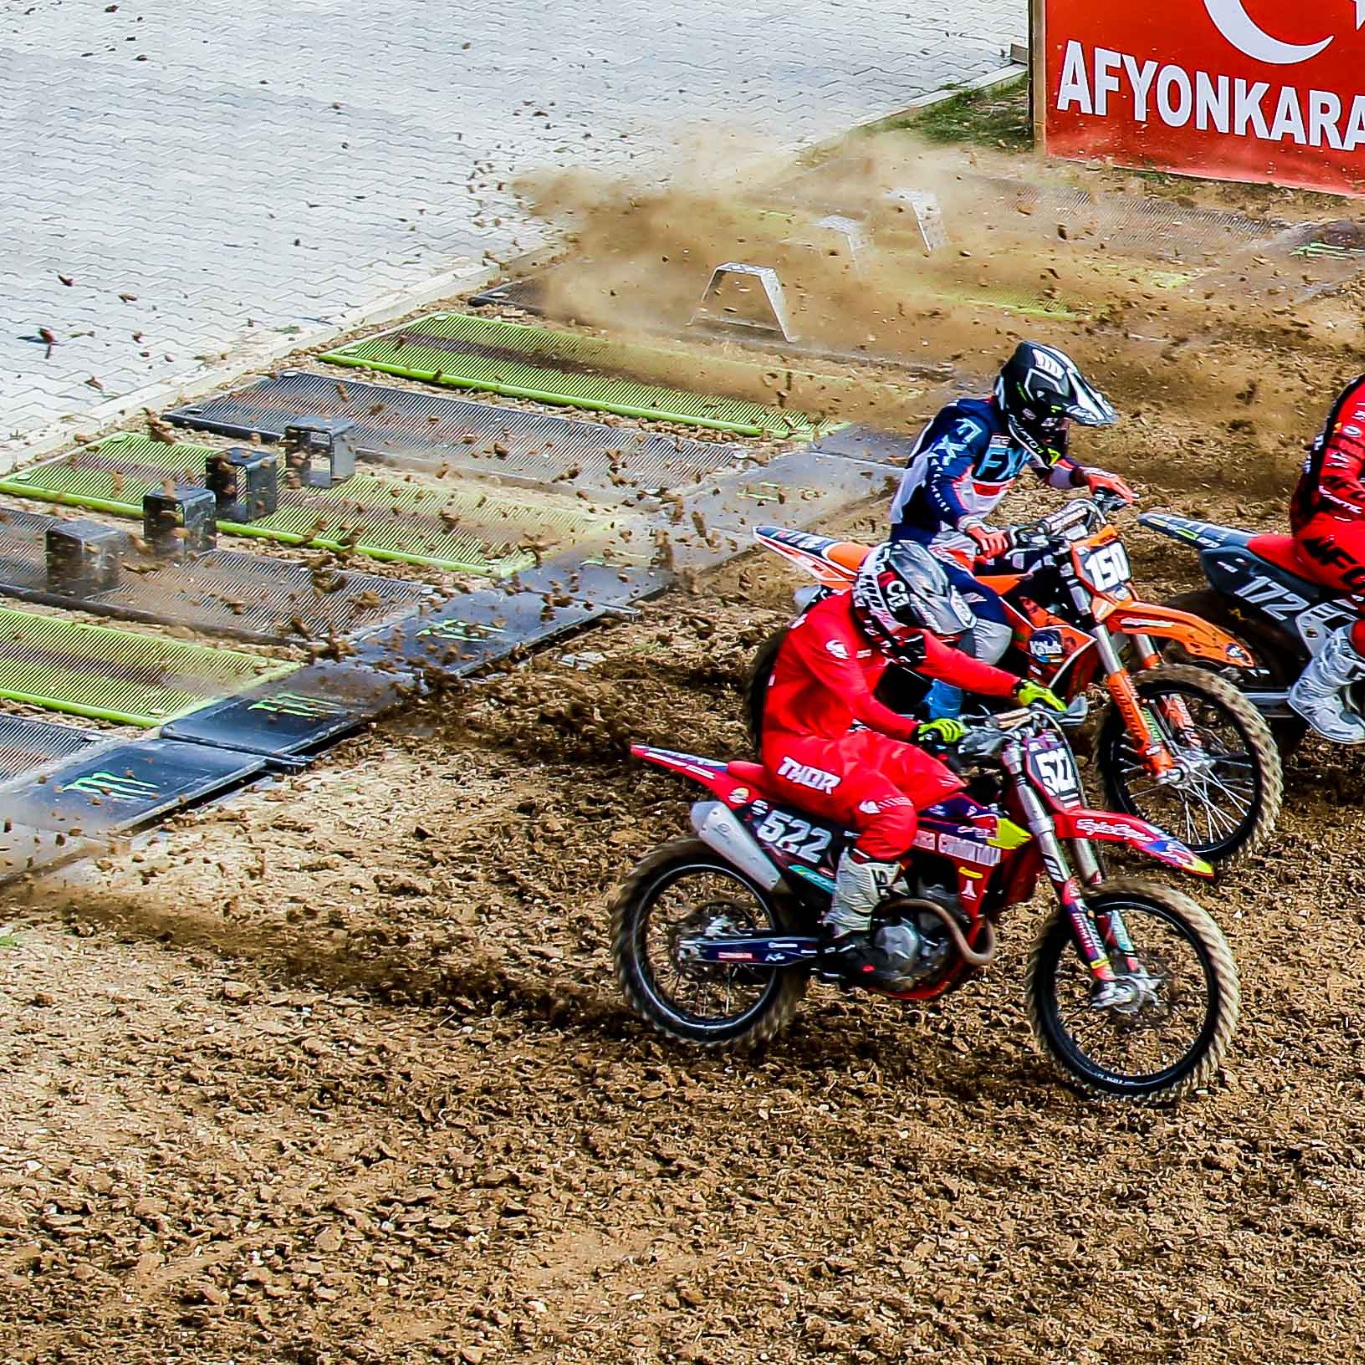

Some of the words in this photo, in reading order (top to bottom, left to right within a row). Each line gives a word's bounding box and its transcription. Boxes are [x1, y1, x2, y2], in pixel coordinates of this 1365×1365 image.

[1085, 541, 1131, 592] 150
[1235, 576, 1311, 621] 172
[777, 756, 841, 795] THOR
[757, 810, 832, 864] 522
